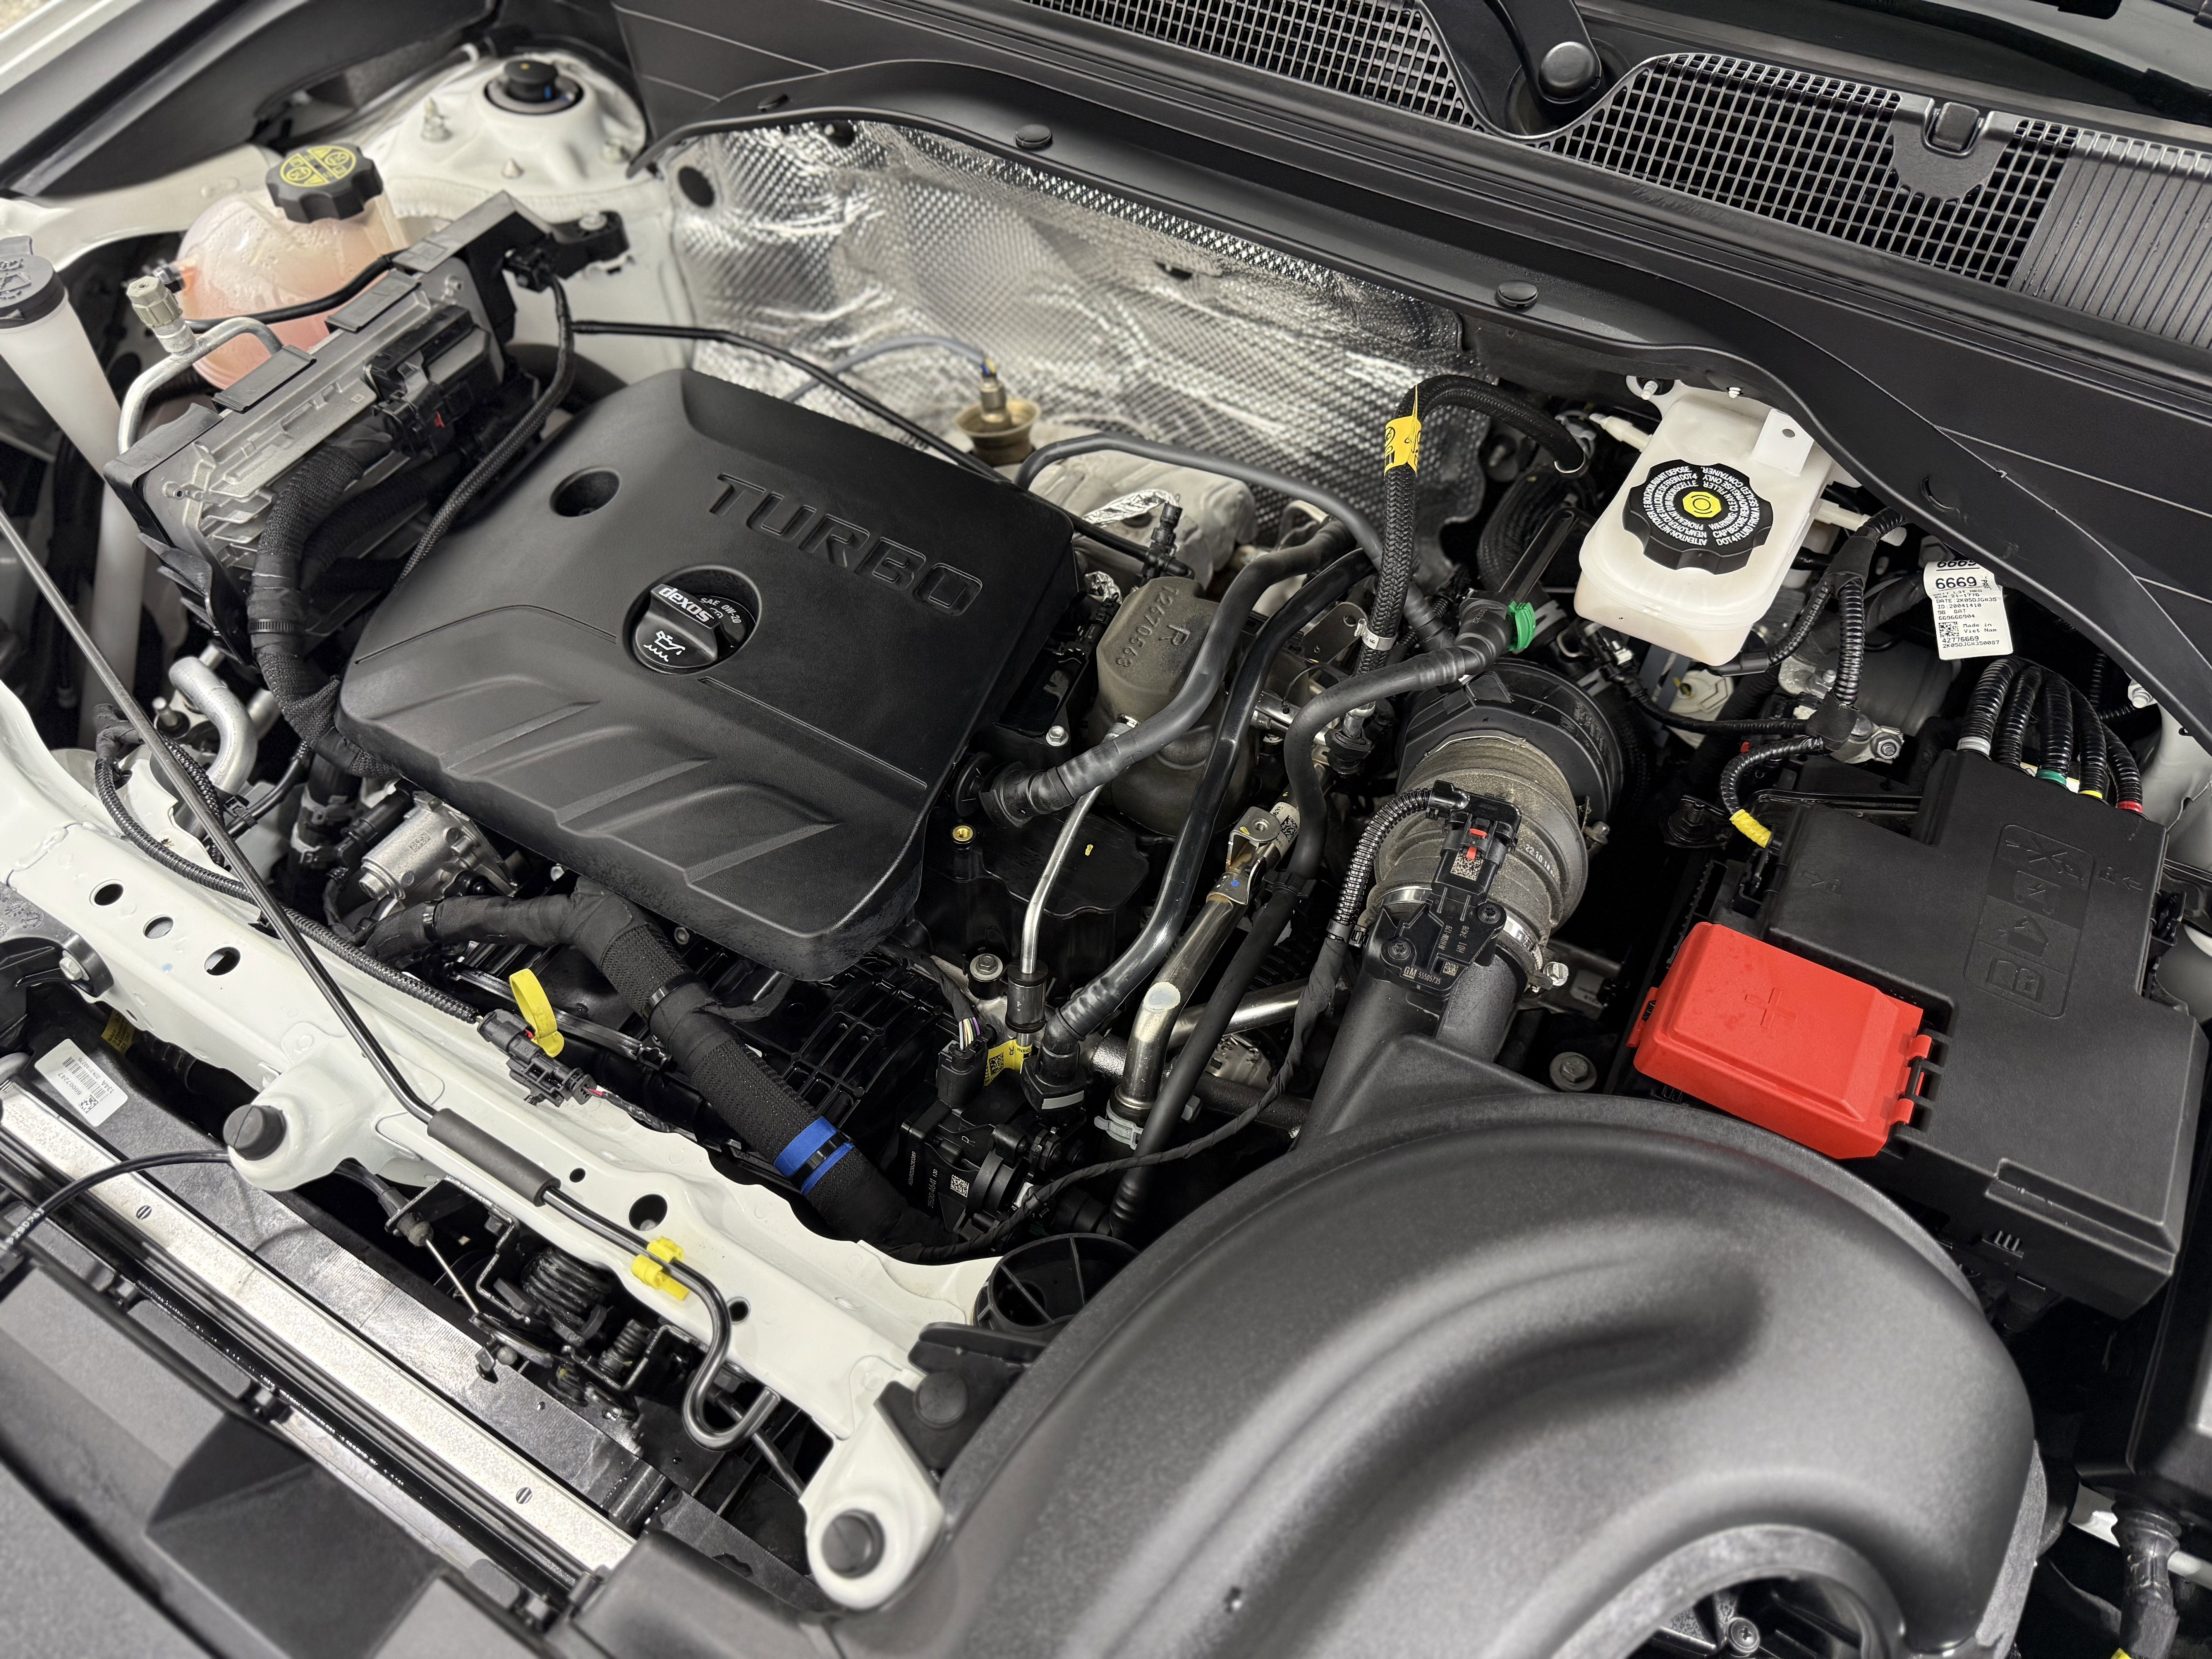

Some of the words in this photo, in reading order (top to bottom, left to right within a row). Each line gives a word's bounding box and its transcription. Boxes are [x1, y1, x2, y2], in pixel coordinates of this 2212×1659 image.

[1650, 472, 1668, 486] AVANT
[1663, 476, 1681, 487] FREIN
[1702, 474, 1722, 484] ONLY
[1721, 481, 1737, 491] USE
[1643, 484, 1656, 504] BOUCHON
[1665, 488, 1678, 501] BIDON
[1703, 481, 1728, 495] FILLER
[1724, 494, 1738, 511] CLEAN
[1740, 487, 1759, 507] SEALED
[1647, 511, 1672, 533] NETTOYER
[1668, 511, 1704, 532] PROVENANT
[1708, 512, 1737, 532] WARNING:
[1726, 516, 1748, 534] BEFORE
[1747, 511, 1760, 527] FROM
[1713, 529, 1727, 538] CAP
[709, 473, 983, 617] TURBO
[1936, 576, 1977, 589] 6669
[658, 587, 714, 622] dexos
[700, 598, 721, 606] SAE
[721, 604, 742, 624] 0W-20
[1116, 586, 1179, 666] 12670563
[1159, 624, 1190, 646] R
[1460, 926, 1469, 938] 2428
[1403, 966, 1417, 979] GM
[1418, 971, 1441, 985] 55505735
[1009, 1046, 1014, 1055] R
[101, 1080, 114, 1094] 134A
[962, 1136, 975, 1147] R
